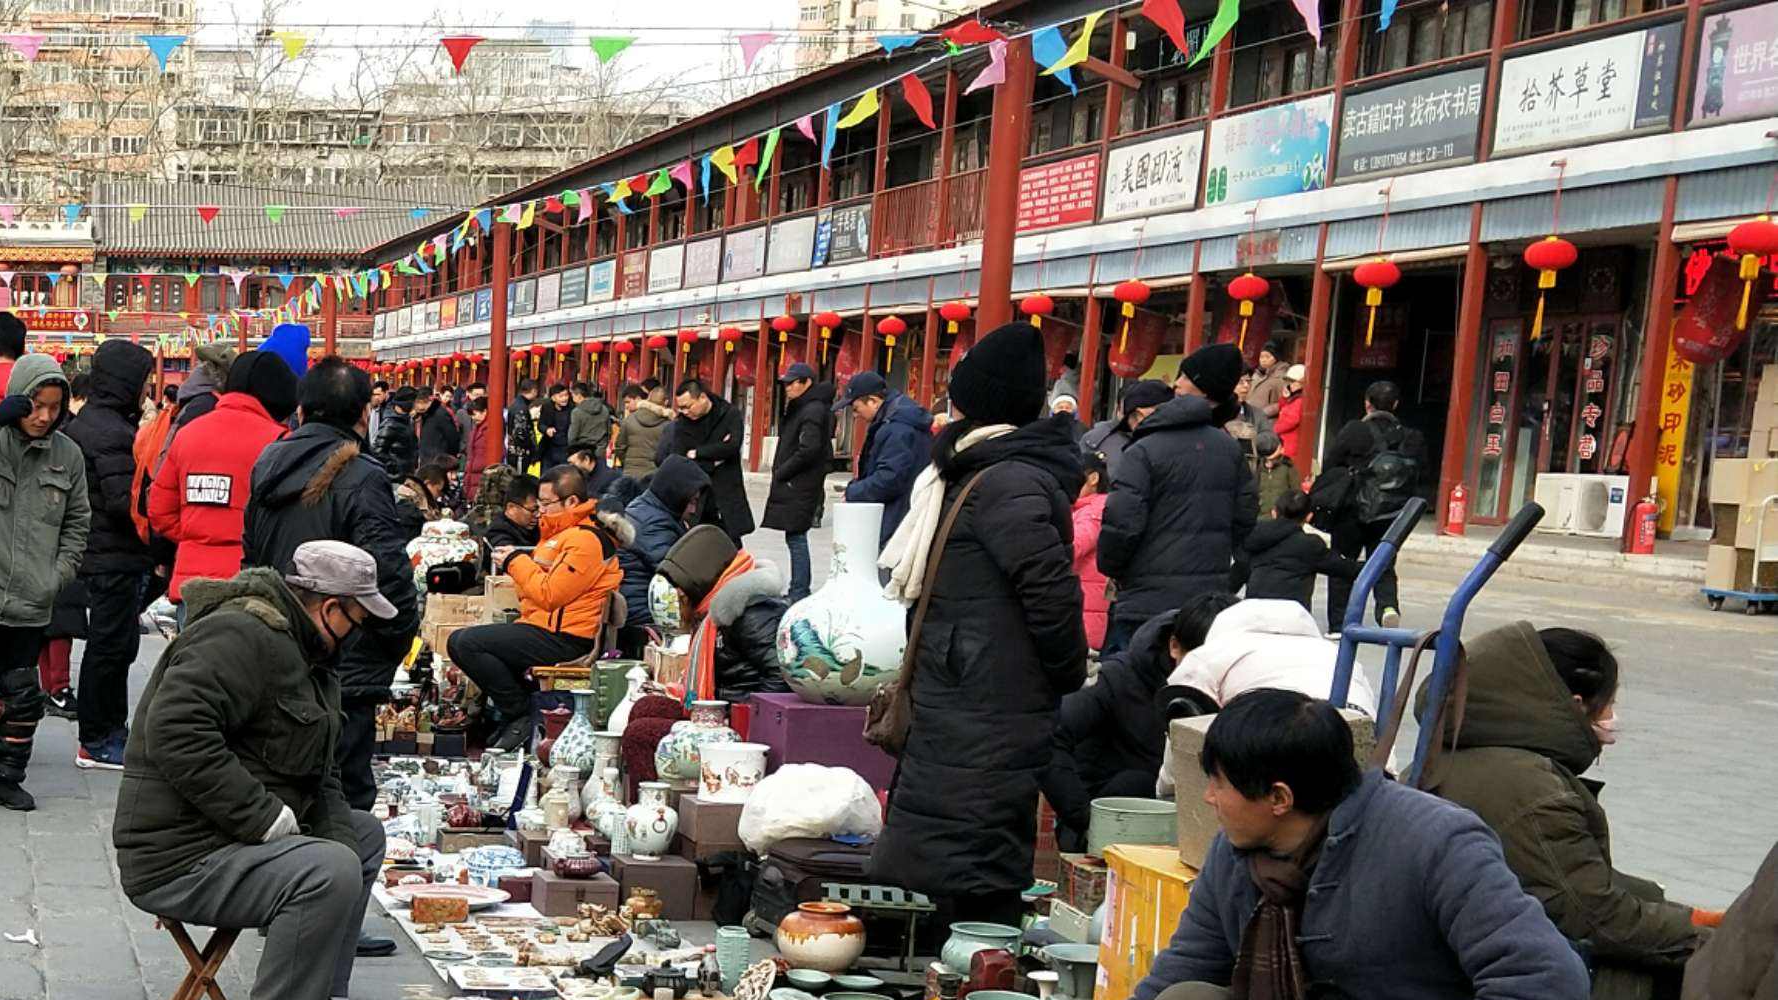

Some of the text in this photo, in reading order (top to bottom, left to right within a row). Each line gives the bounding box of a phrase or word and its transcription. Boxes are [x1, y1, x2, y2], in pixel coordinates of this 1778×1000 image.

[1343, 98, 1406, 139] 卖古籍旧书
[1410, 83, 1482, 128] 找布衣书局
